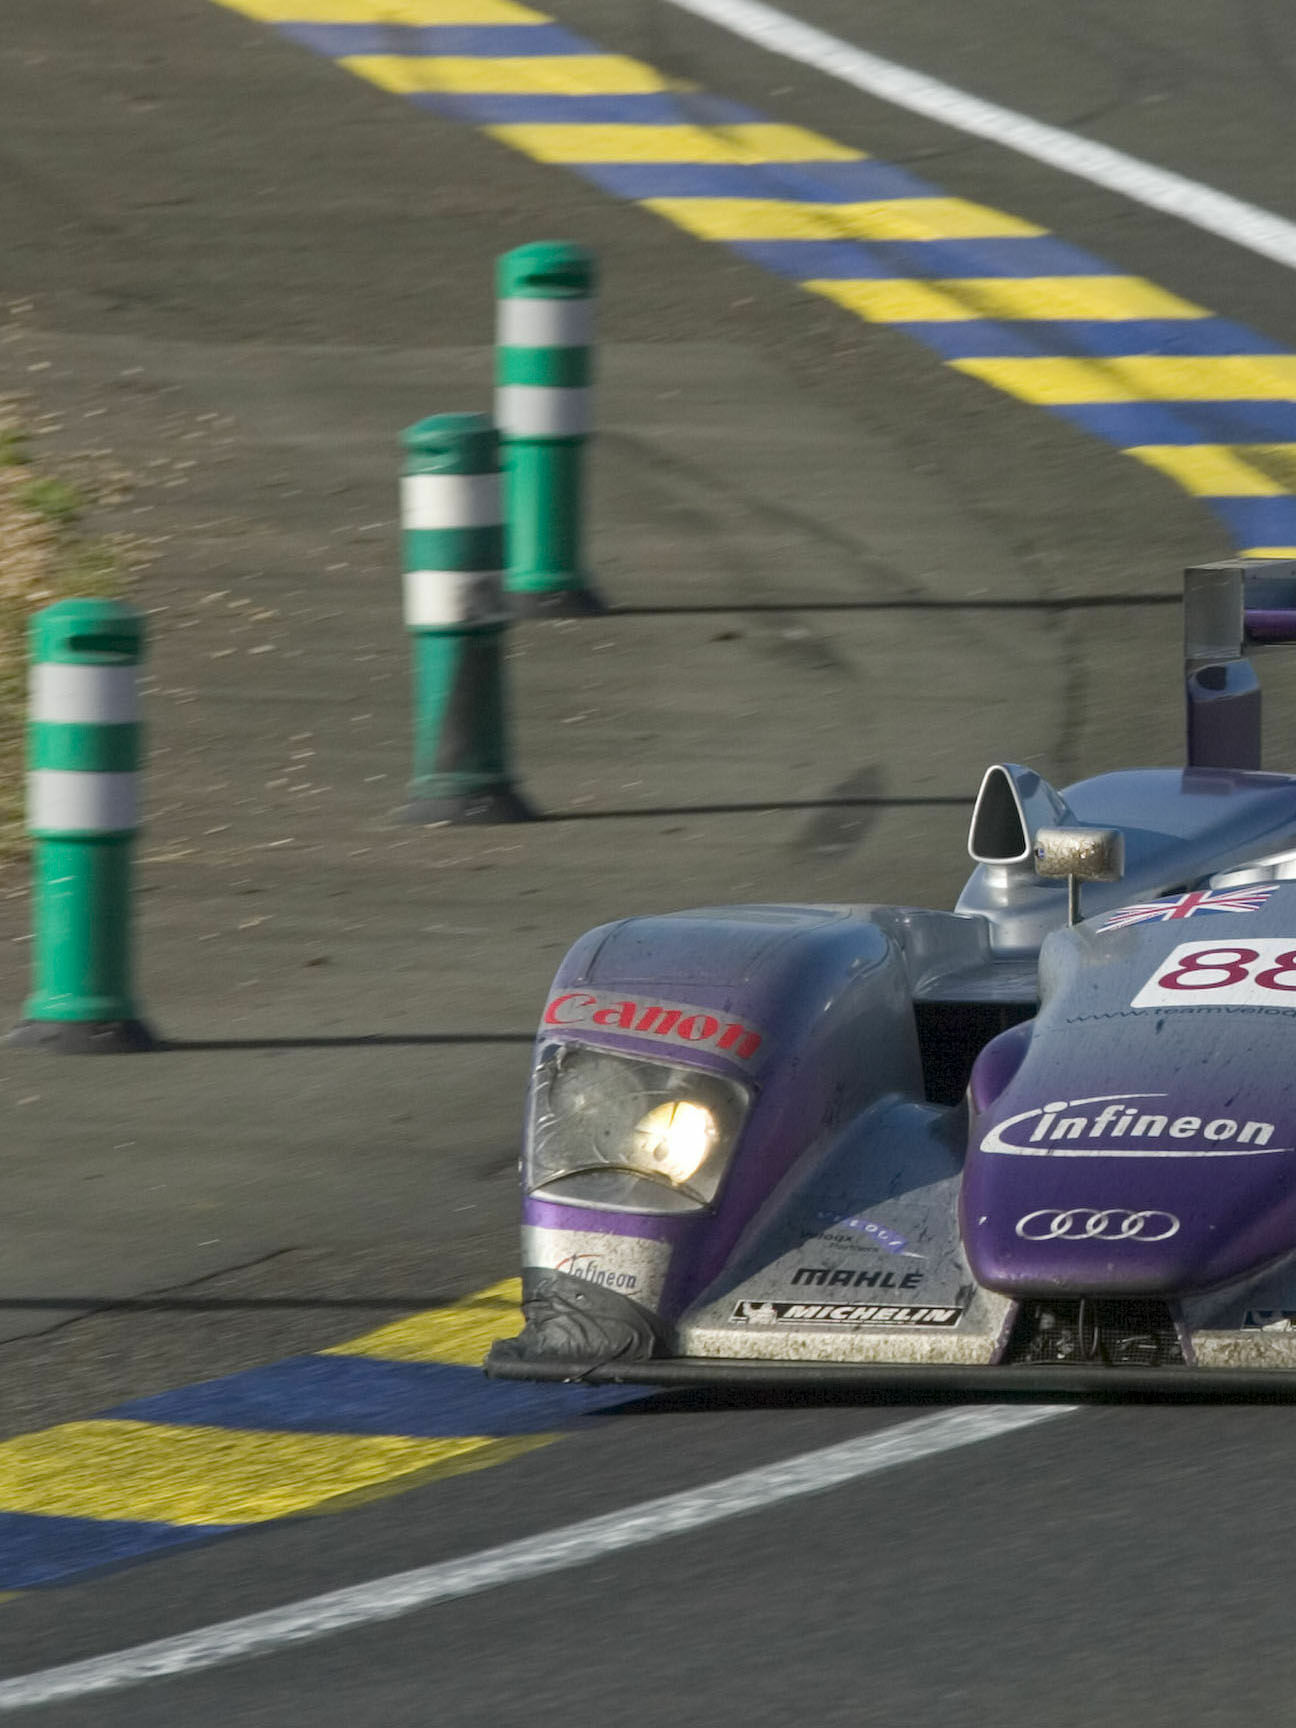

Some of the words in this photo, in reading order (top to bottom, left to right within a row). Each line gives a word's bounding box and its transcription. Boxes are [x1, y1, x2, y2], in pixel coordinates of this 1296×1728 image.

[543, 993, 763, 1060] Canon
[791, 1267, 924, 1289] MAHLE
[783, 1304, 956, 1322] MICHELIN
